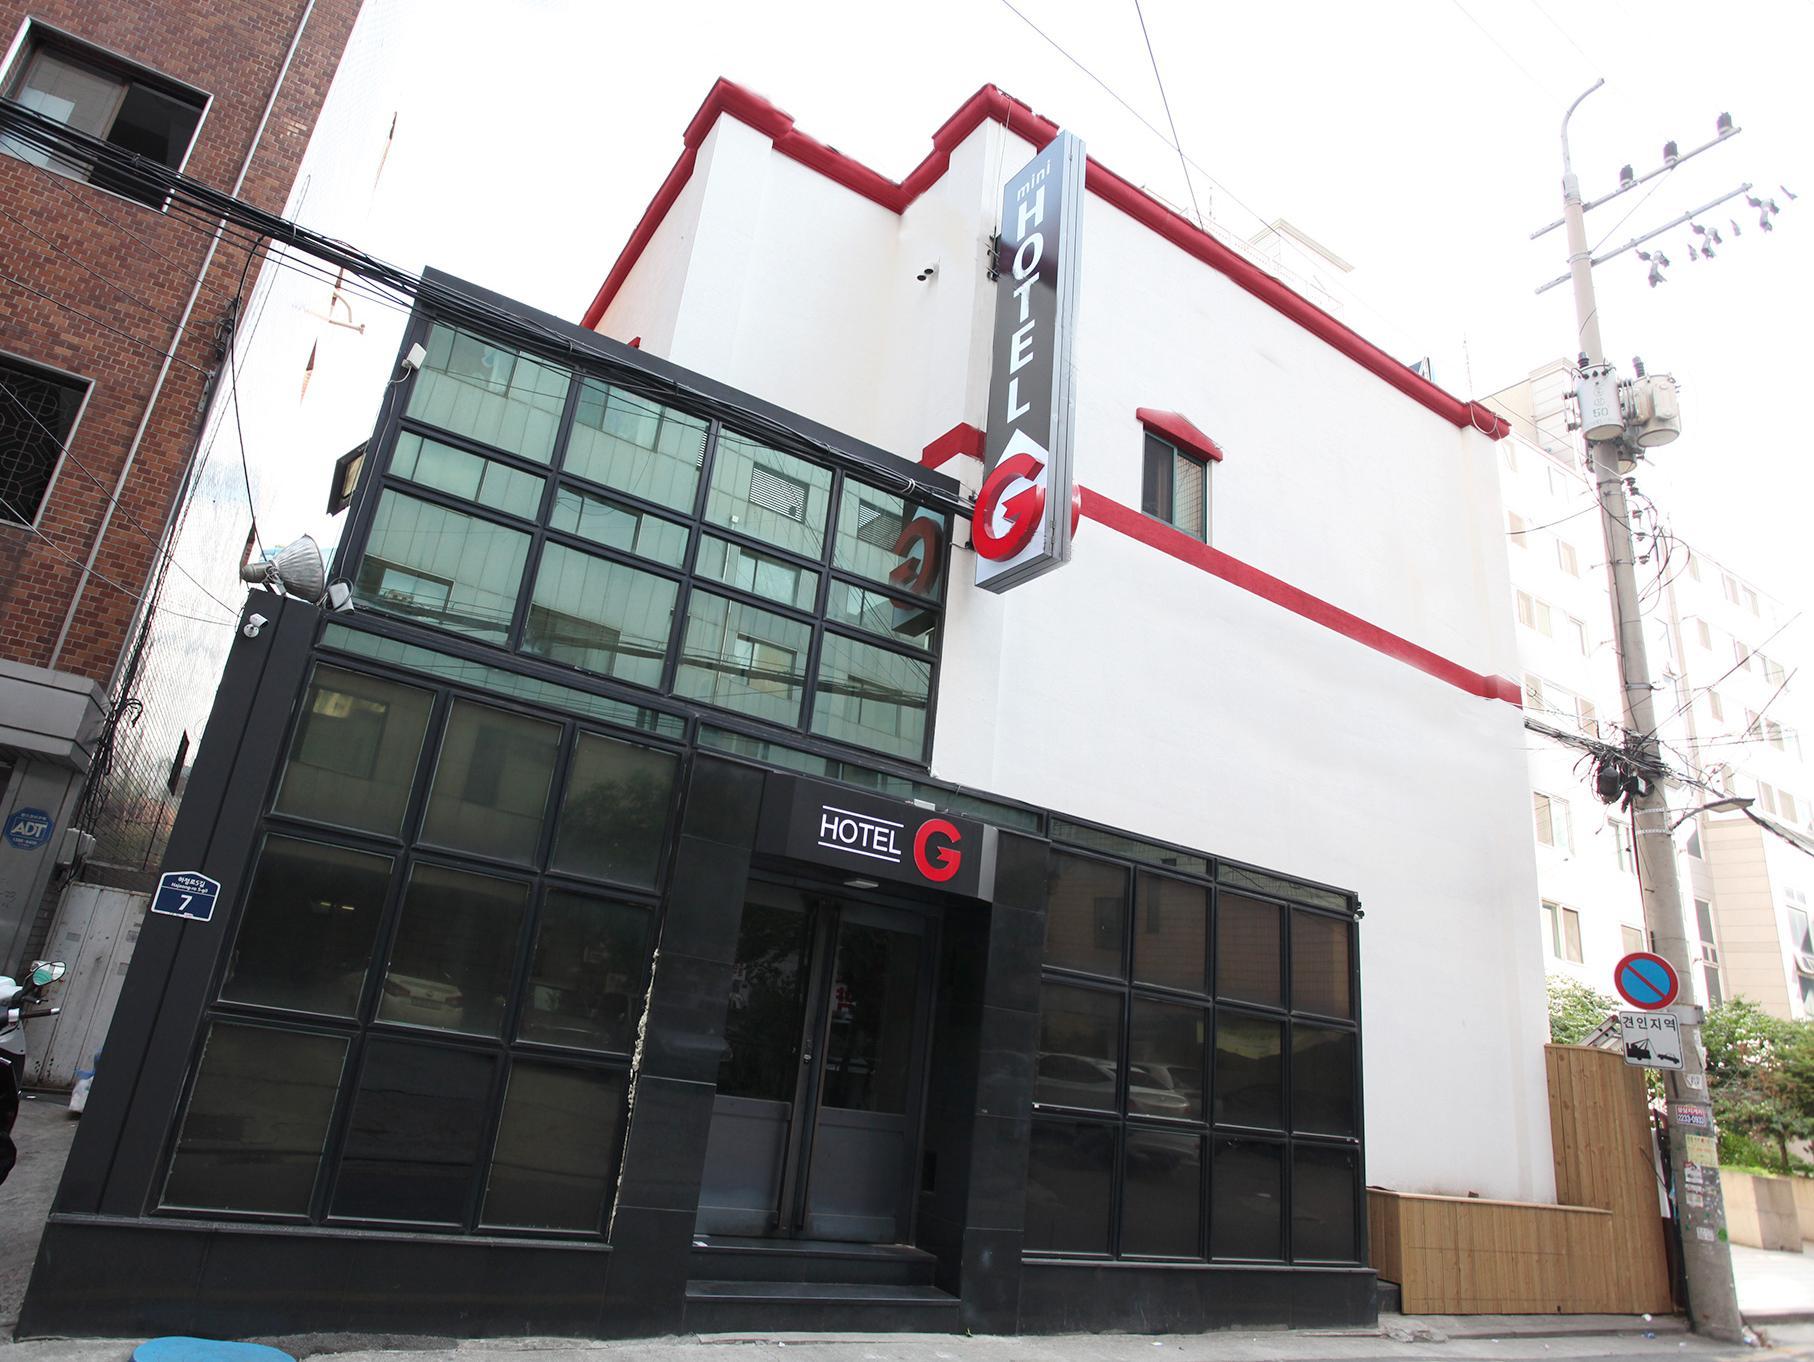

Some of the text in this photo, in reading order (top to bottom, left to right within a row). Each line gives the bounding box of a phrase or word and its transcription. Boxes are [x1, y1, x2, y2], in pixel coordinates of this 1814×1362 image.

[1016, 159, 1051, 202] mini
[1006, 185, 1044, 423] HOTEL
[972, 452, 1046, 562] G
[11, 821, 48, 838] ADT
[820, 813, 962, 882] HOTEL G
[178, 894, 193, 911] 7
[1622, 1016, 1676, 1031] 견인지역
